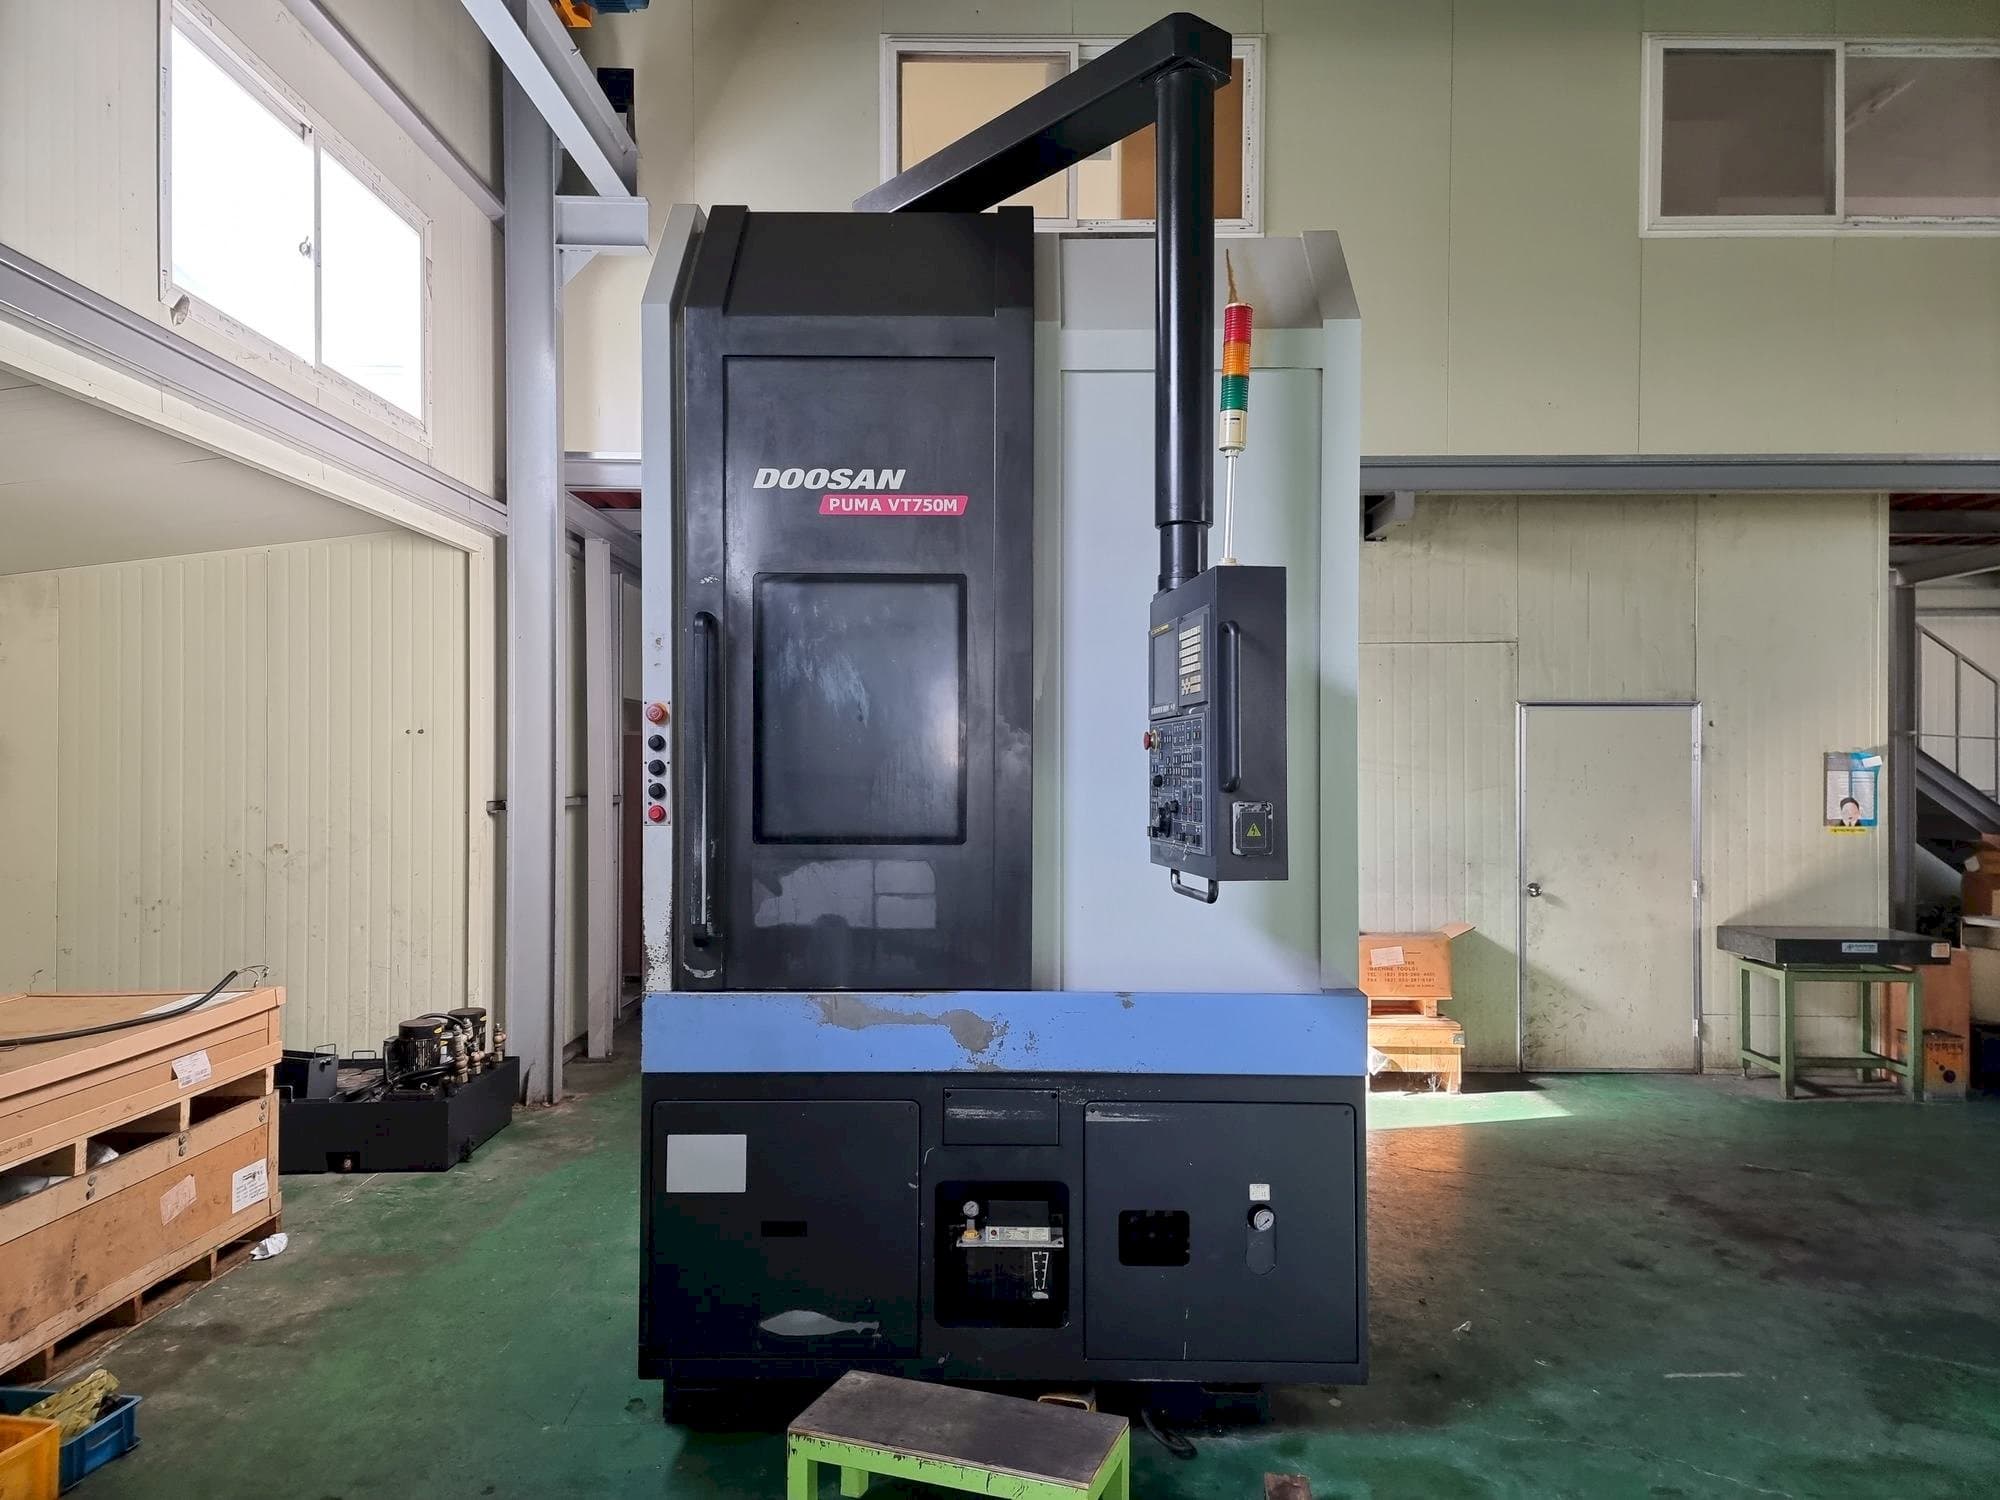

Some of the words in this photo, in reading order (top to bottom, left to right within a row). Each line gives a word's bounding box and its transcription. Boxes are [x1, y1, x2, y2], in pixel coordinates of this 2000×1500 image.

[752, 468, 906, 489] DOOSAN
[829, 498, 882, 511] PUMA
[888, 498, 958, 512] VT750M
